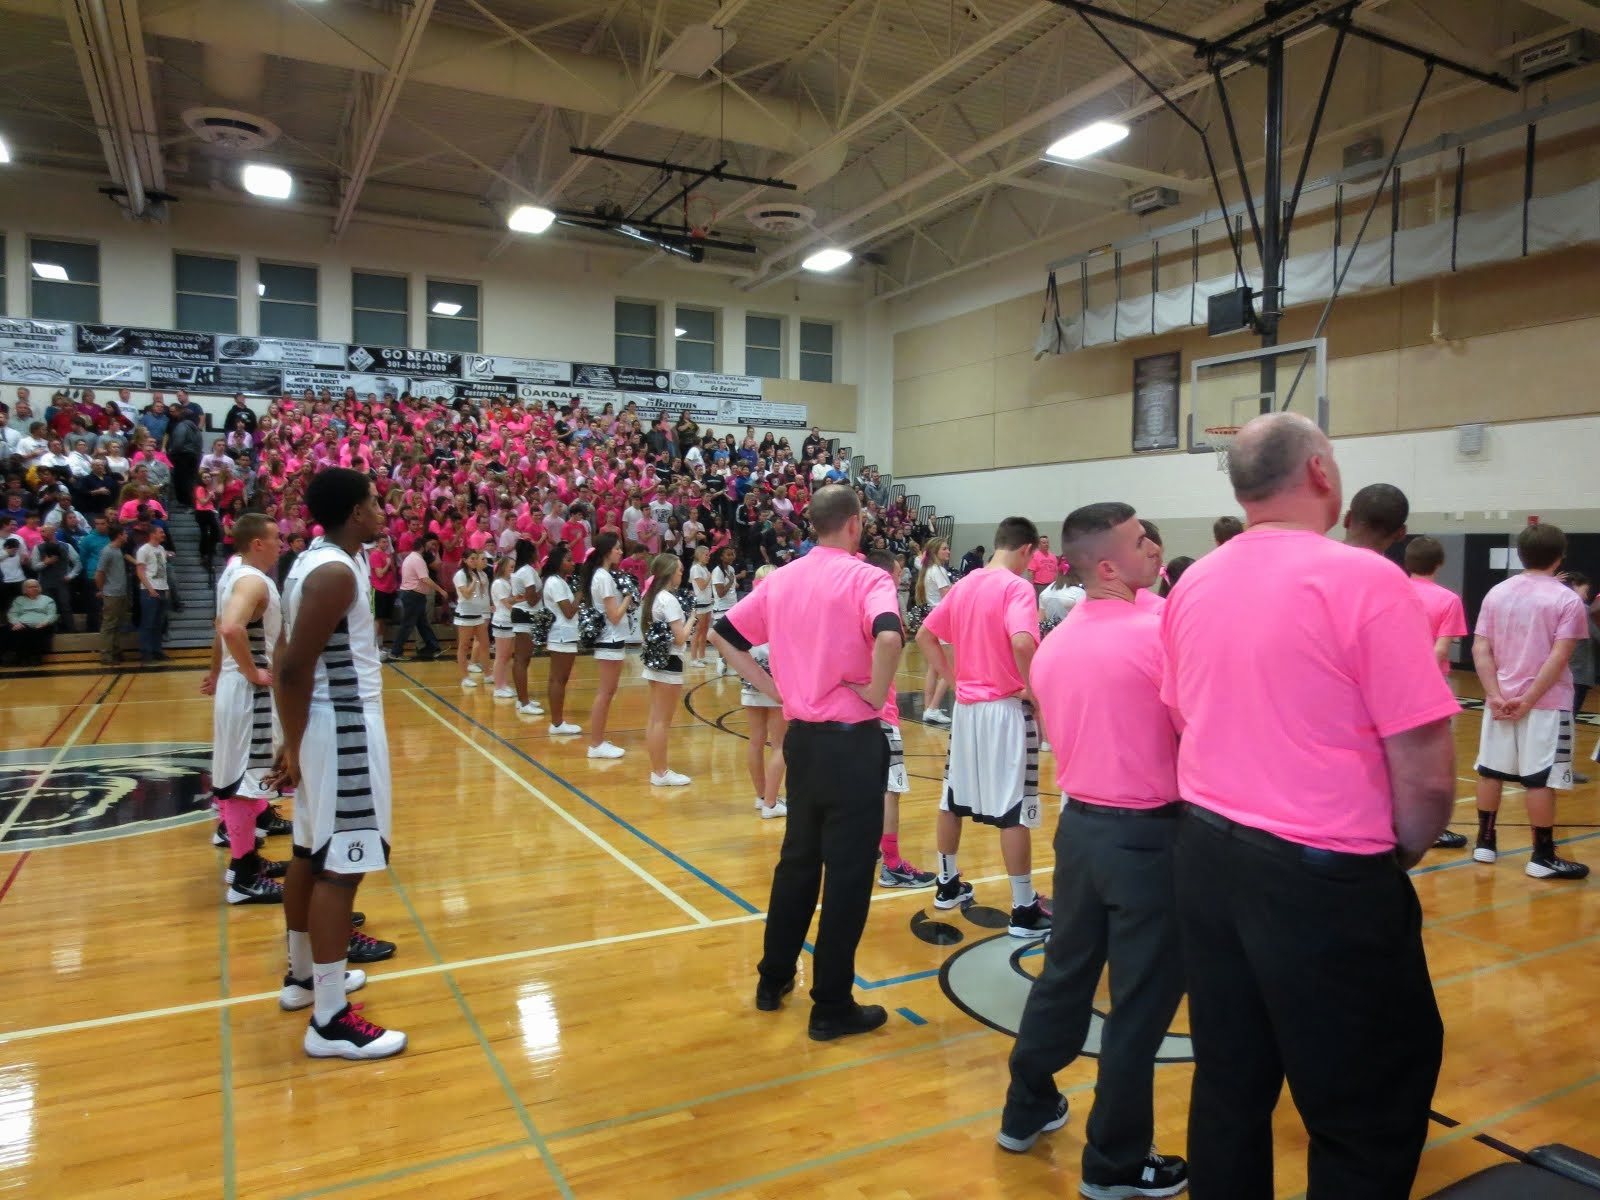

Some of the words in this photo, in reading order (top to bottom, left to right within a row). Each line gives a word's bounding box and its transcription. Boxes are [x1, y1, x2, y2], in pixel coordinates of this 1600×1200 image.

[381, 349, 403, 360] GO
[407, 350, 452, 365] BEARS!
[151, 366, 191, 375] ATHLETIC
[285, 369, 319, 378] OAKDALE
[294, 377, 312, 385] NEW
[285, 382, 313, 391] DUNKIN
[315, 384, 344, 392] DONUTS
[521, 387, 585, 400] OAKDALE
[655, 398, 698, 409] Barrons
